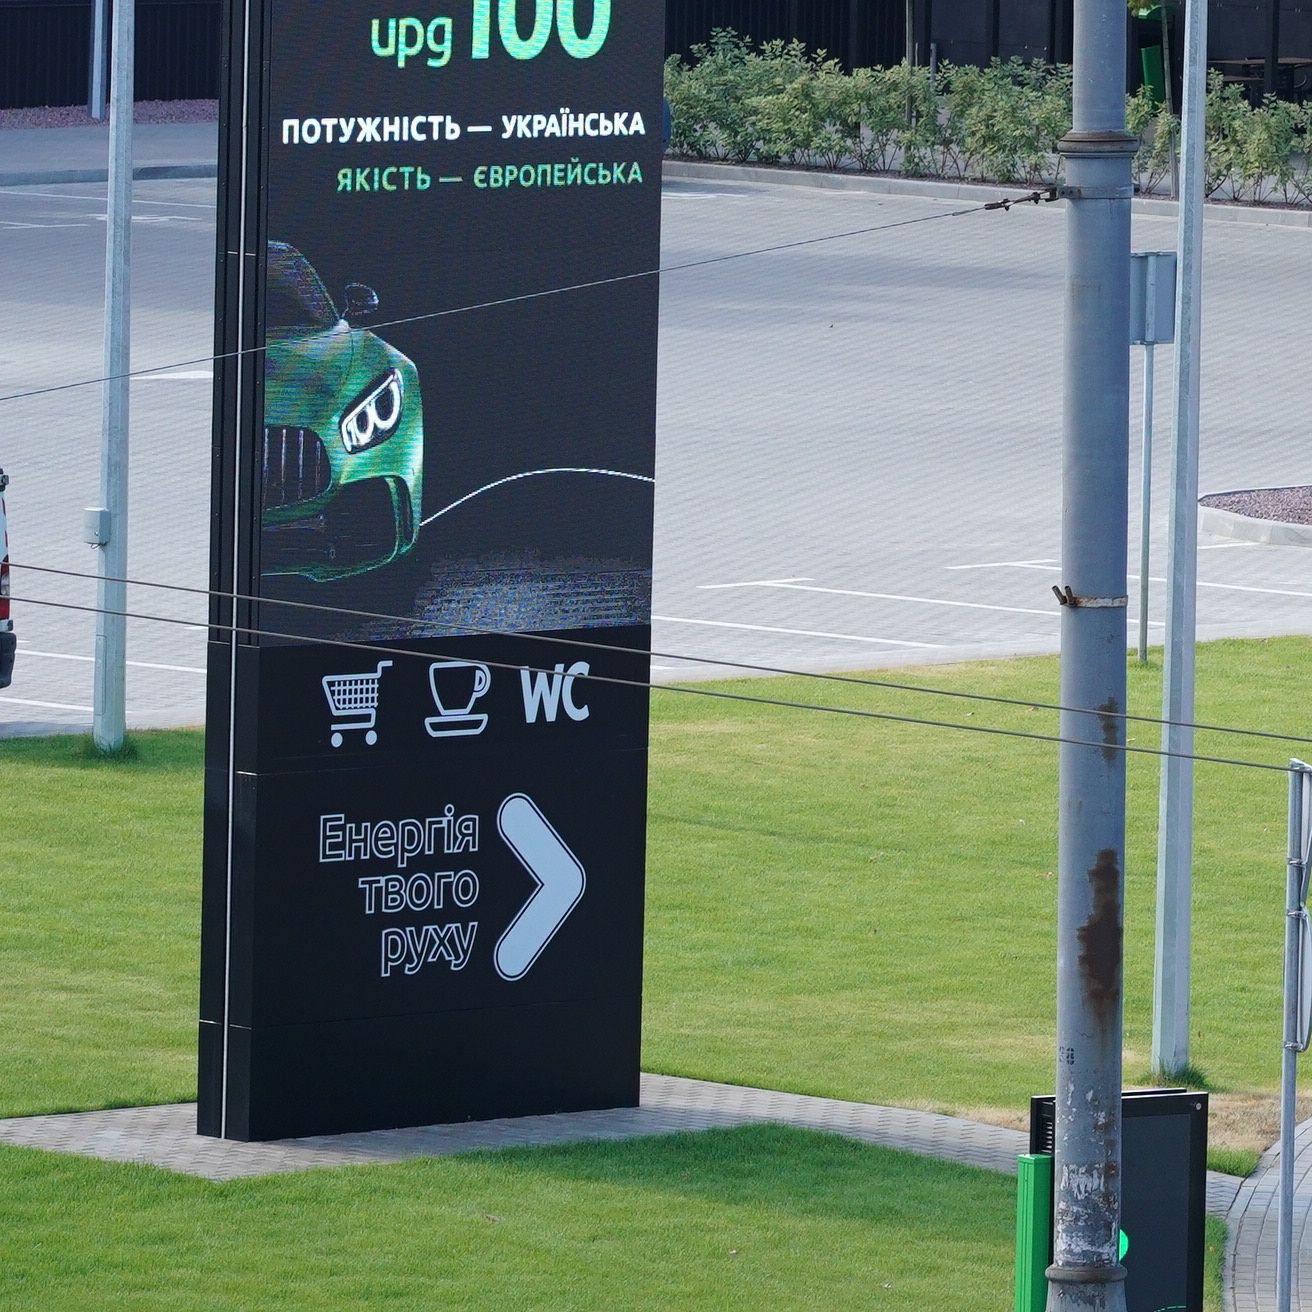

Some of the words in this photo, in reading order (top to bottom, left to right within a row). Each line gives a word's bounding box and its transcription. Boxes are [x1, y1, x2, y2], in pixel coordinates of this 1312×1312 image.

[371, 17, 453, 68] upg
[282, 115, 460, 144] ПОТУЖНІСТЬ
[501, 107, 646, 140] УКРАЇНСЬКА
[336, 165, 431, 192] ЯКІСТЬ
[473, 156, 643, 189] ЄВРОПЕЙСЬКА
[520, 661, 590, 723] WC
[319, 804, 479, 868] Енергія
[358, 869, 480, 914] твого
[381, 921, 478, 977] руху
